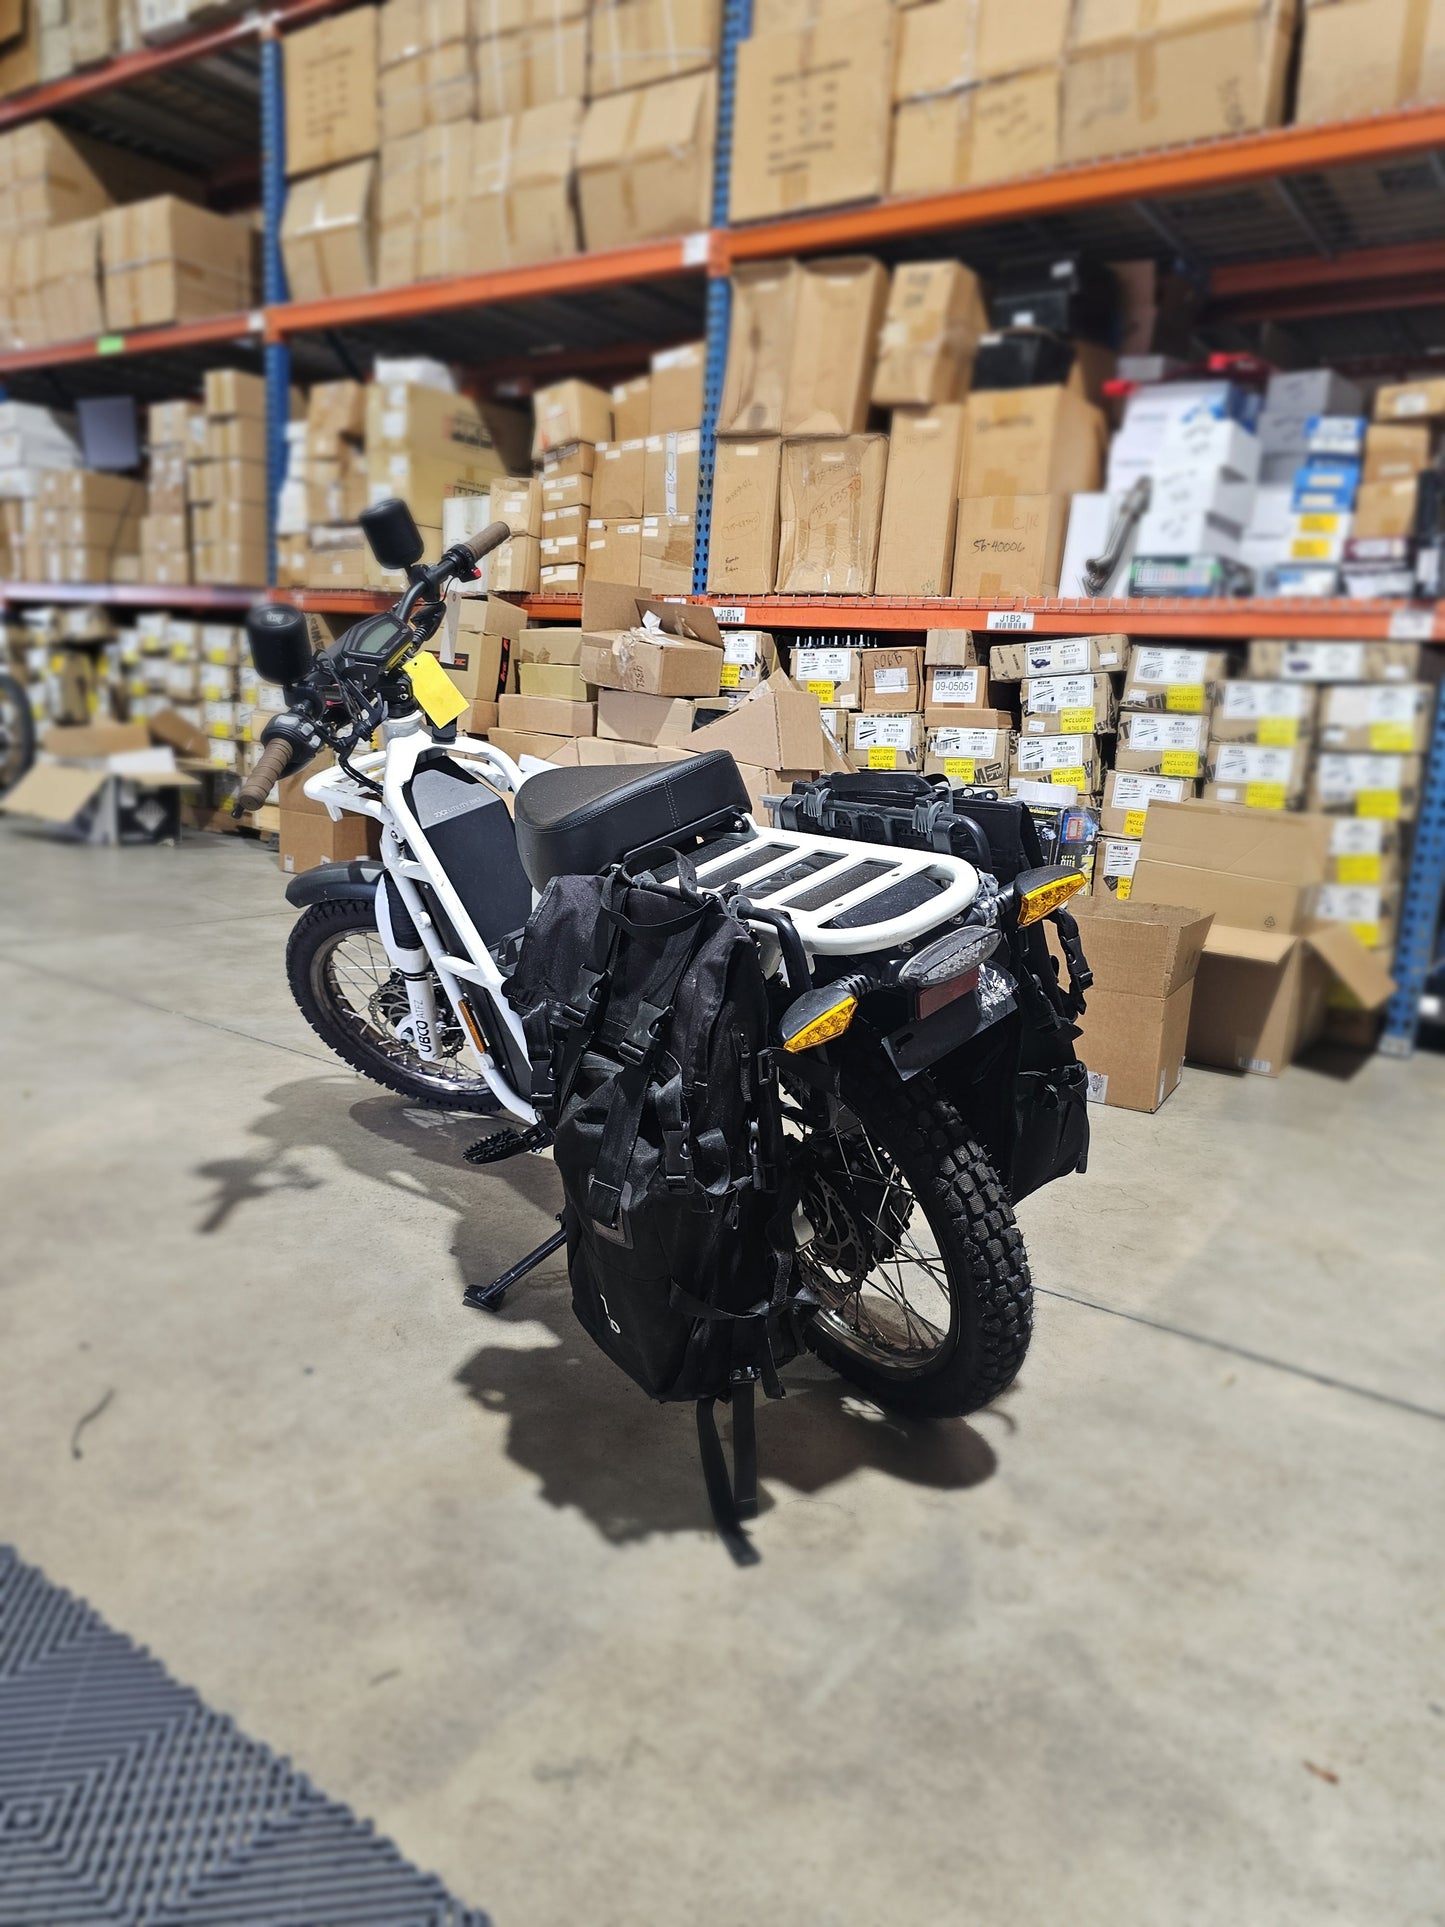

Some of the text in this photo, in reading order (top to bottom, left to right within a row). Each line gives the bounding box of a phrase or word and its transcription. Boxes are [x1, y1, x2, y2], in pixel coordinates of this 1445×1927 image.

[1000, 615, 1021, 623] J1B2
[935, 682, 974, 691] 09-05051
[416, 1020, 432, 1053] UBCO
